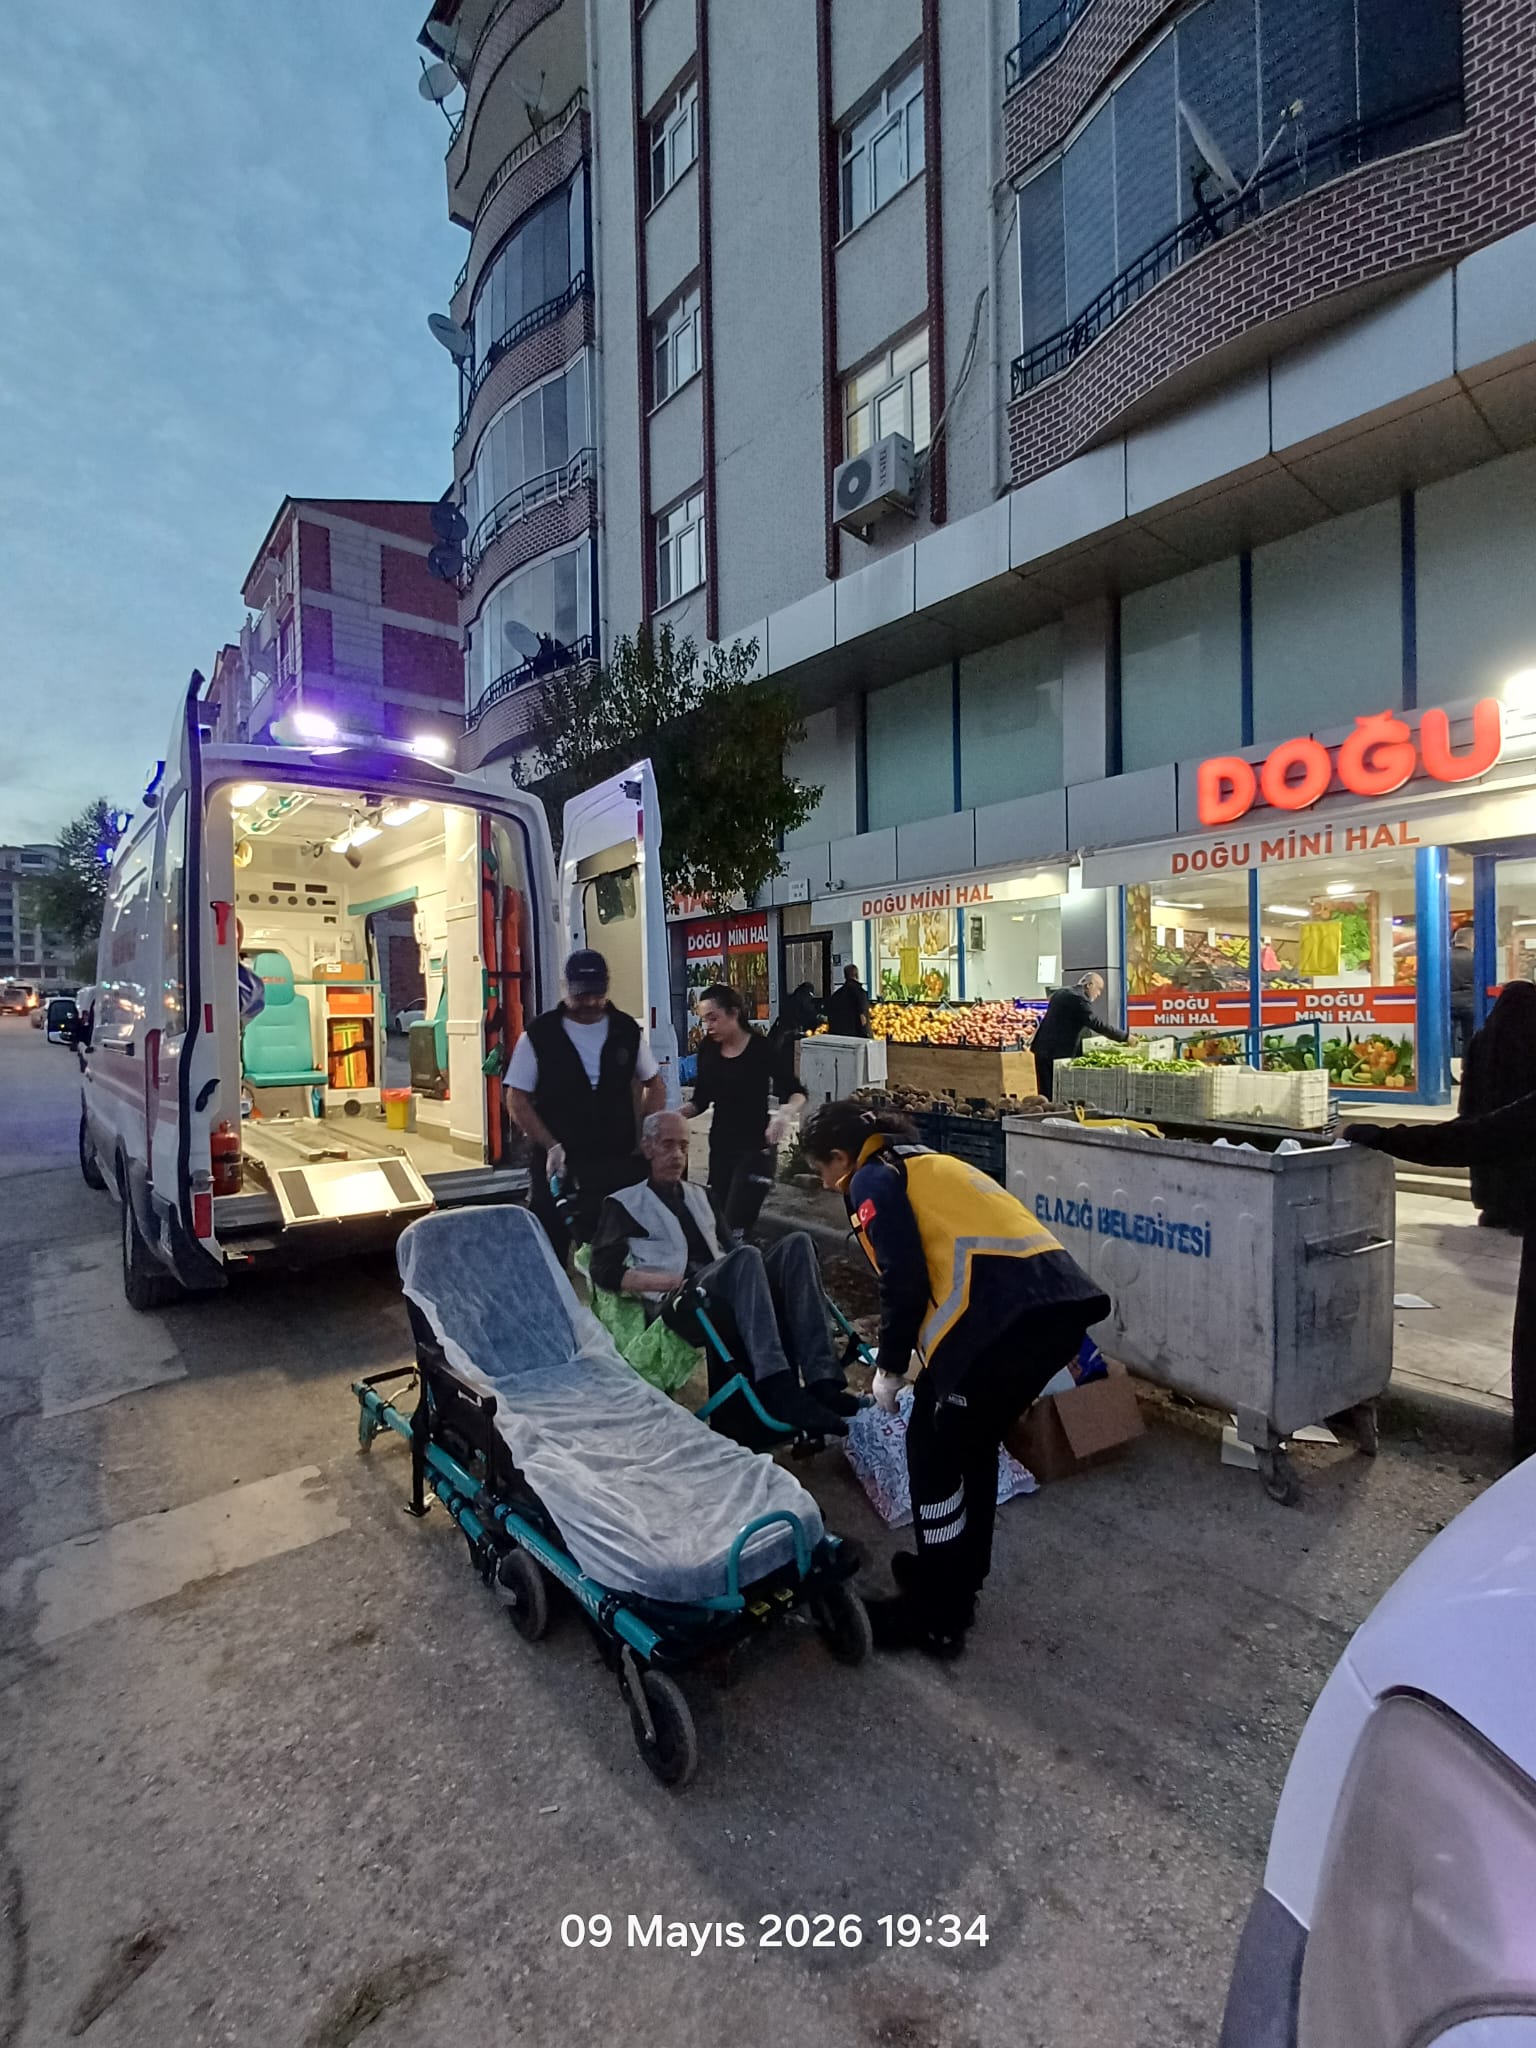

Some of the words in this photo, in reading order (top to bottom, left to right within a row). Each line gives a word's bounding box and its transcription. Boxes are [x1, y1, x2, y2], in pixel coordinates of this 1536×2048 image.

[1197, 697, 1502, 825] DOĞU
[1171, 841, 1250, 874] DOĞU
[1260, 824, 1333, 862] MİNİ
[1345, 820, 1420, 851] HAL
[862, 893, 907, 917] DOĞU
[910, 883, 951, 909] MİNİ
[956, 883, 993, 904] HAL
[687, 928, 721, 951] DOĞU
[750, 925, 769, 945] HAL
[1162, 995, 1210, 1011] DOĞU
[1305, 990, 1364, 1007] DOĞU
[1188, 1013, 1219, 1024] HAL
[1337, 1010, 1376, 1022] HAL
[1035, 1192, 1093, 1231] ELAZIĞ
[1097, 1207, 1212, 1258] BELEDİYESİ
